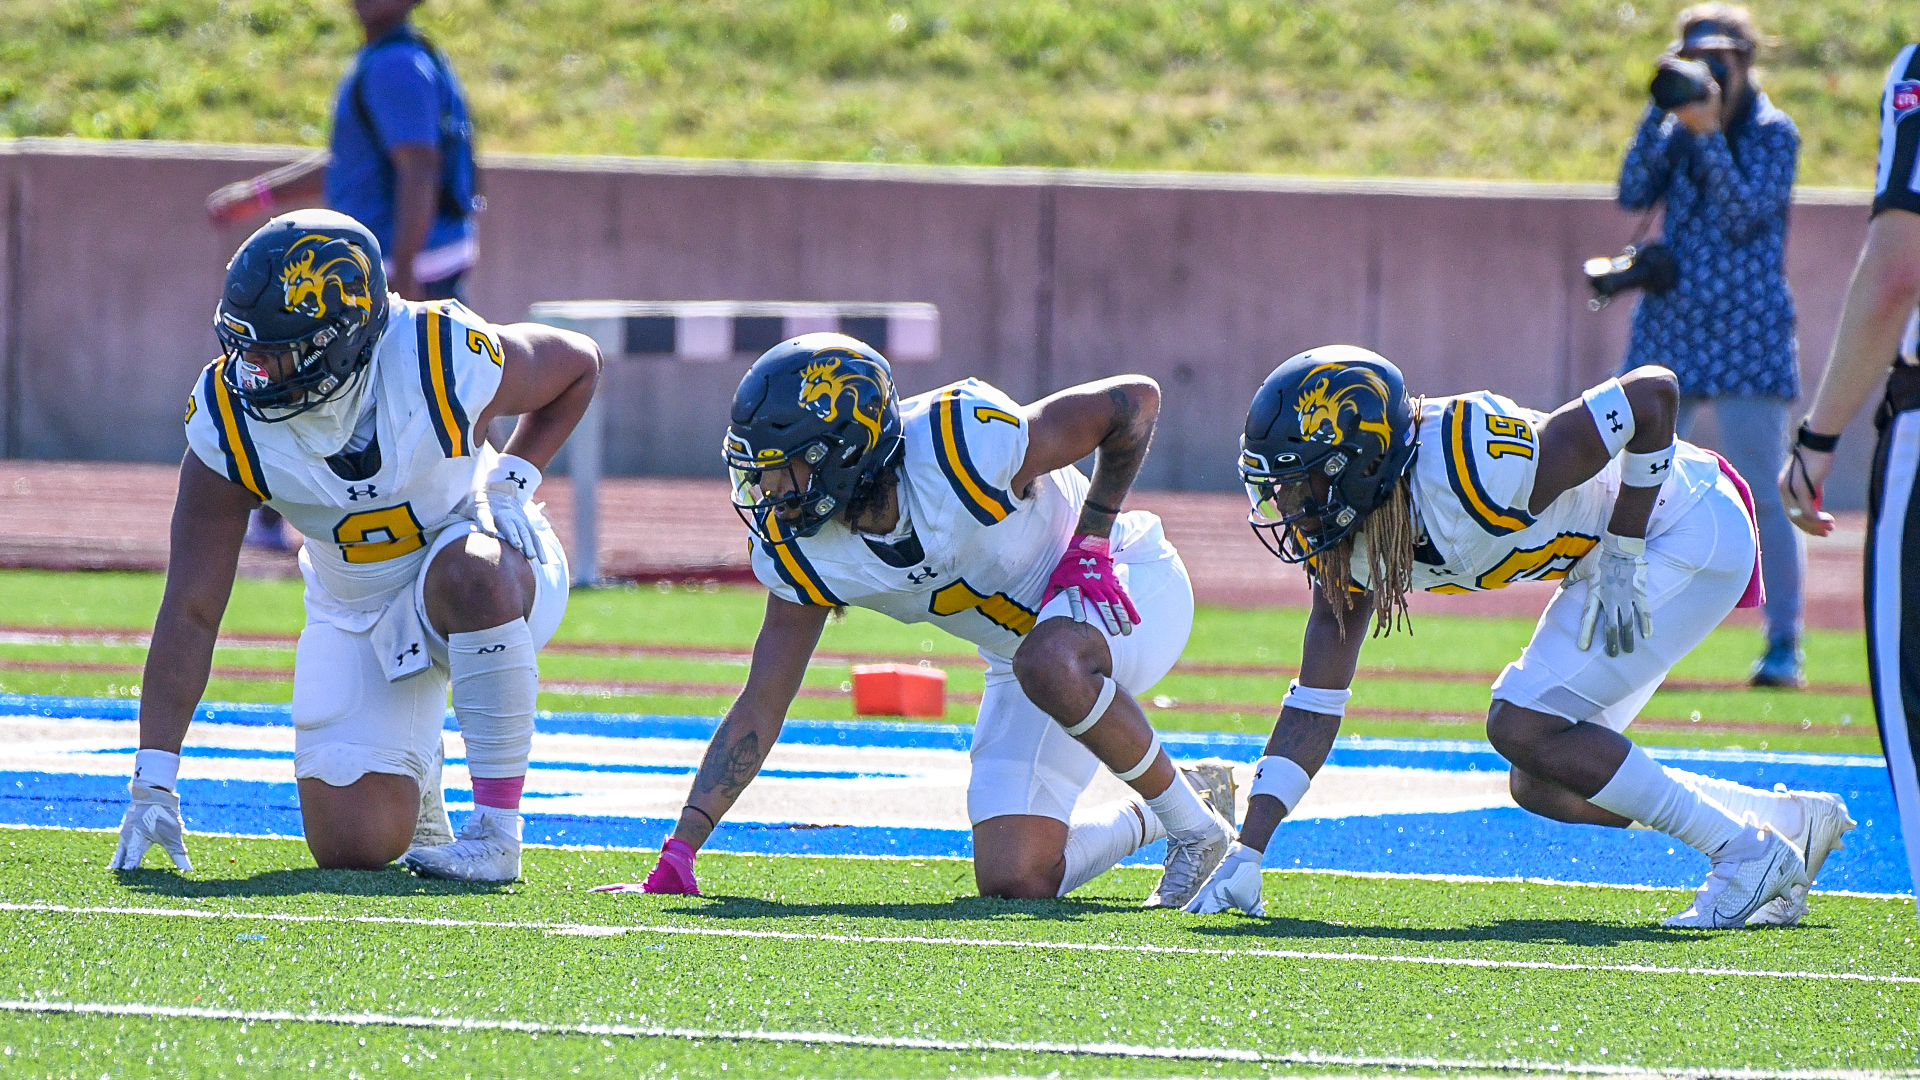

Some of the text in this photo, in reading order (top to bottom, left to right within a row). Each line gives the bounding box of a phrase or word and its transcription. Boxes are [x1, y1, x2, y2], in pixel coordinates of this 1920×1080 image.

[465, 327, 503, 369] 2
[973, 405, 1021, 430] 1
[1484, 413, 1534, 462] 19
[332, 500, 428, 565] 2
[928, 576, 1040, 638] 1
